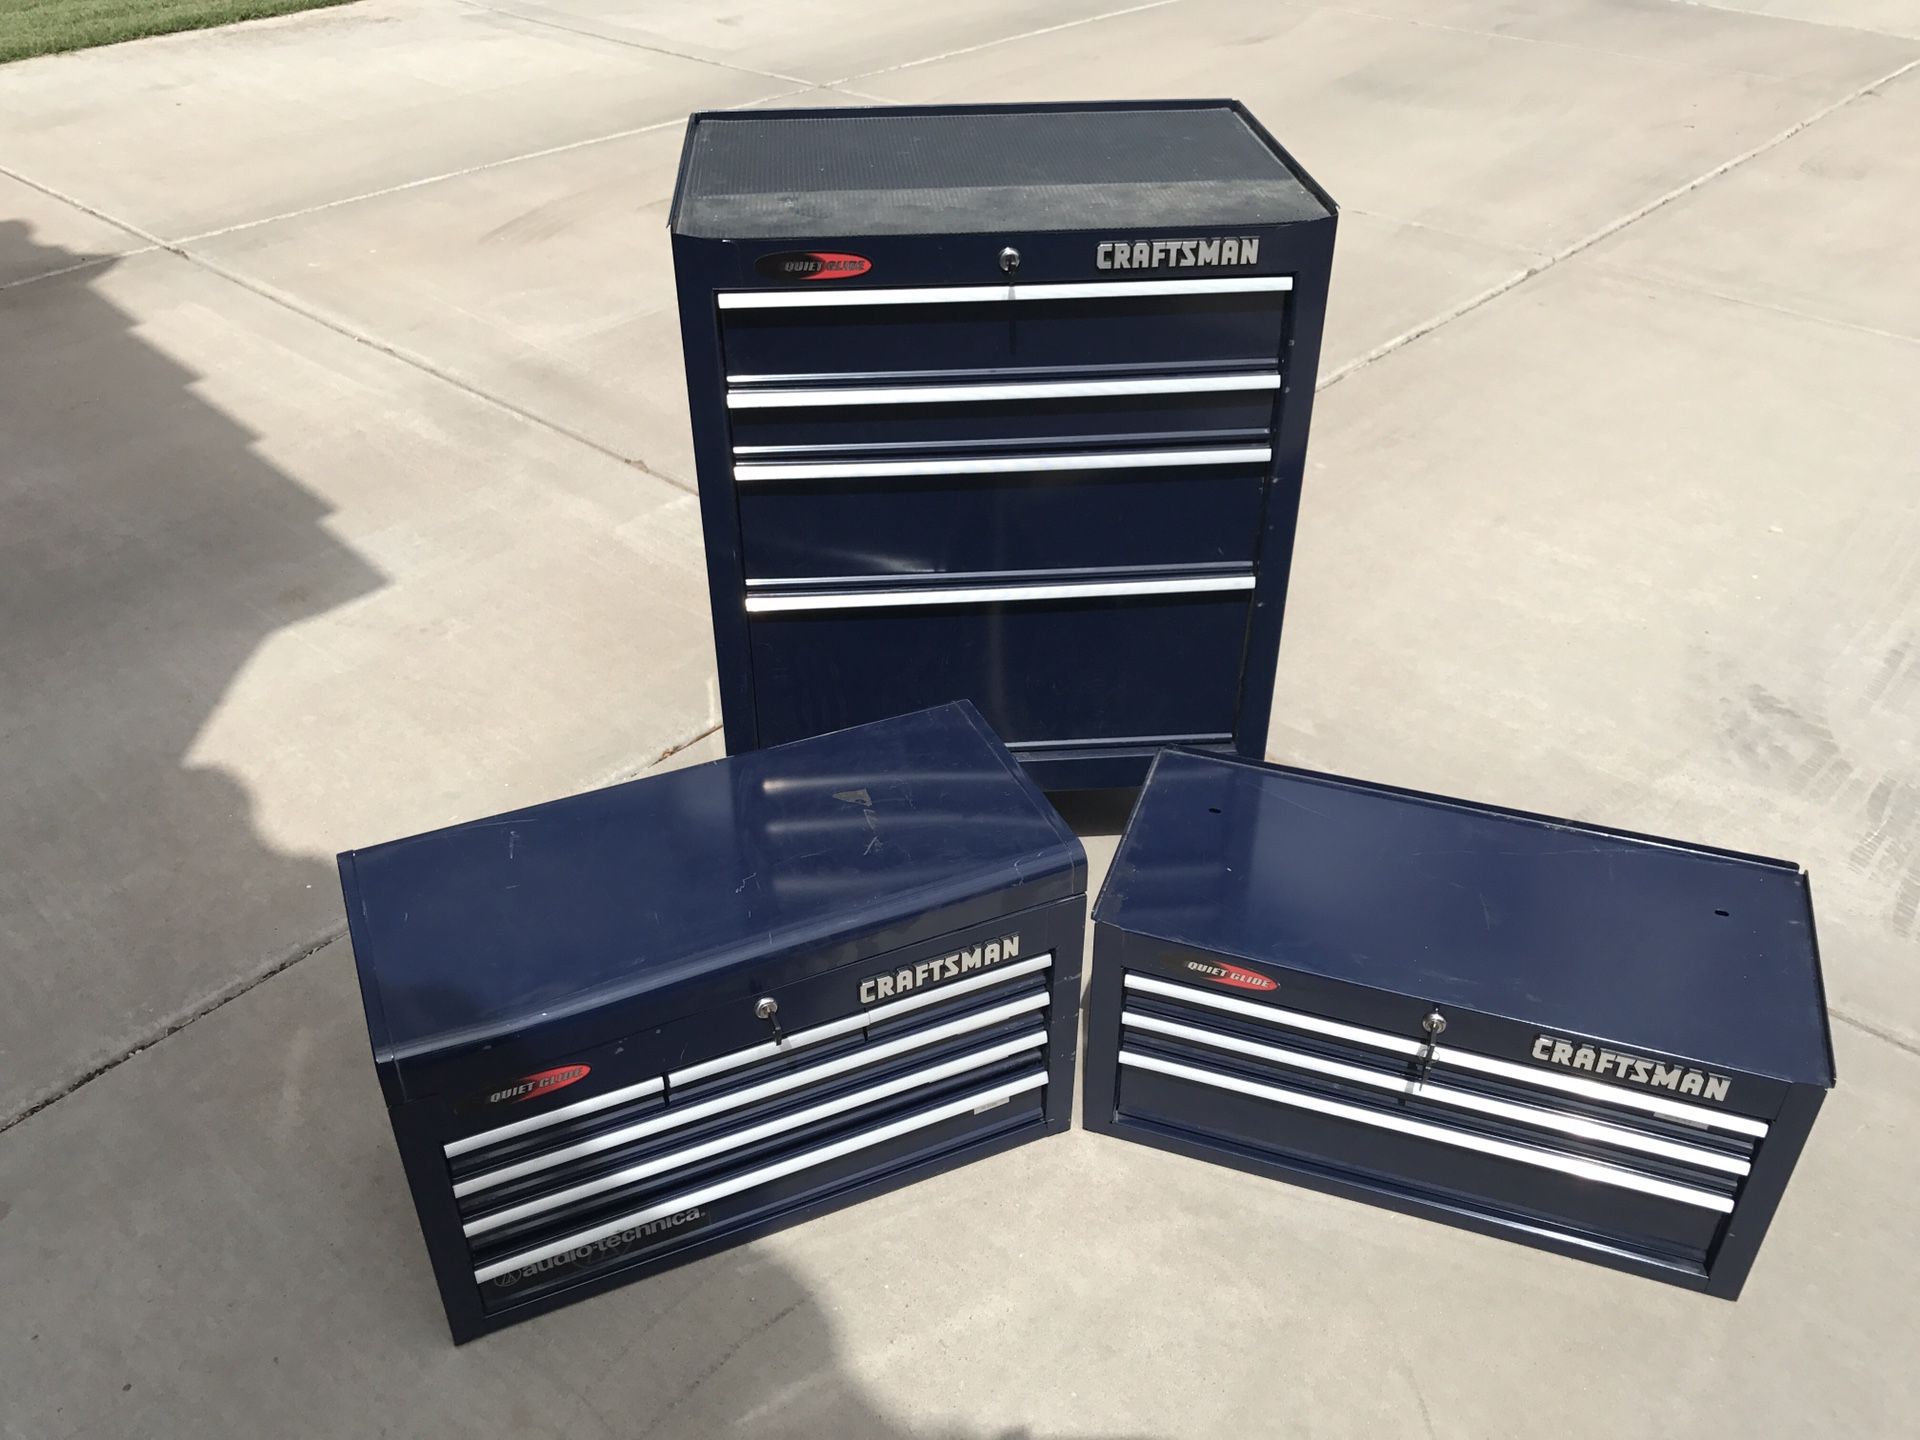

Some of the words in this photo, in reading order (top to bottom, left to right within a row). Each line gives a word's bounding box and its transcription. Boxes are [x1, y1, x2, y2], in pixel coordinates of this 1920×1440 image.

[784, 260, 822, 272] QUIET
[1096, 237, 1260, 270] CRAFTSMAN
[860, 934, 1020, 1004] CRAFTSMAN
[1187, 961, 1229, 977] QUIET
[1230, 972, 1270, 988] GLIDE
[490, 1081, 536, 1103] QUIET
[539, 1068, 583, 1088] GLIDE
[1531, 1035, 1733, 1102] CRAFTSMAN
